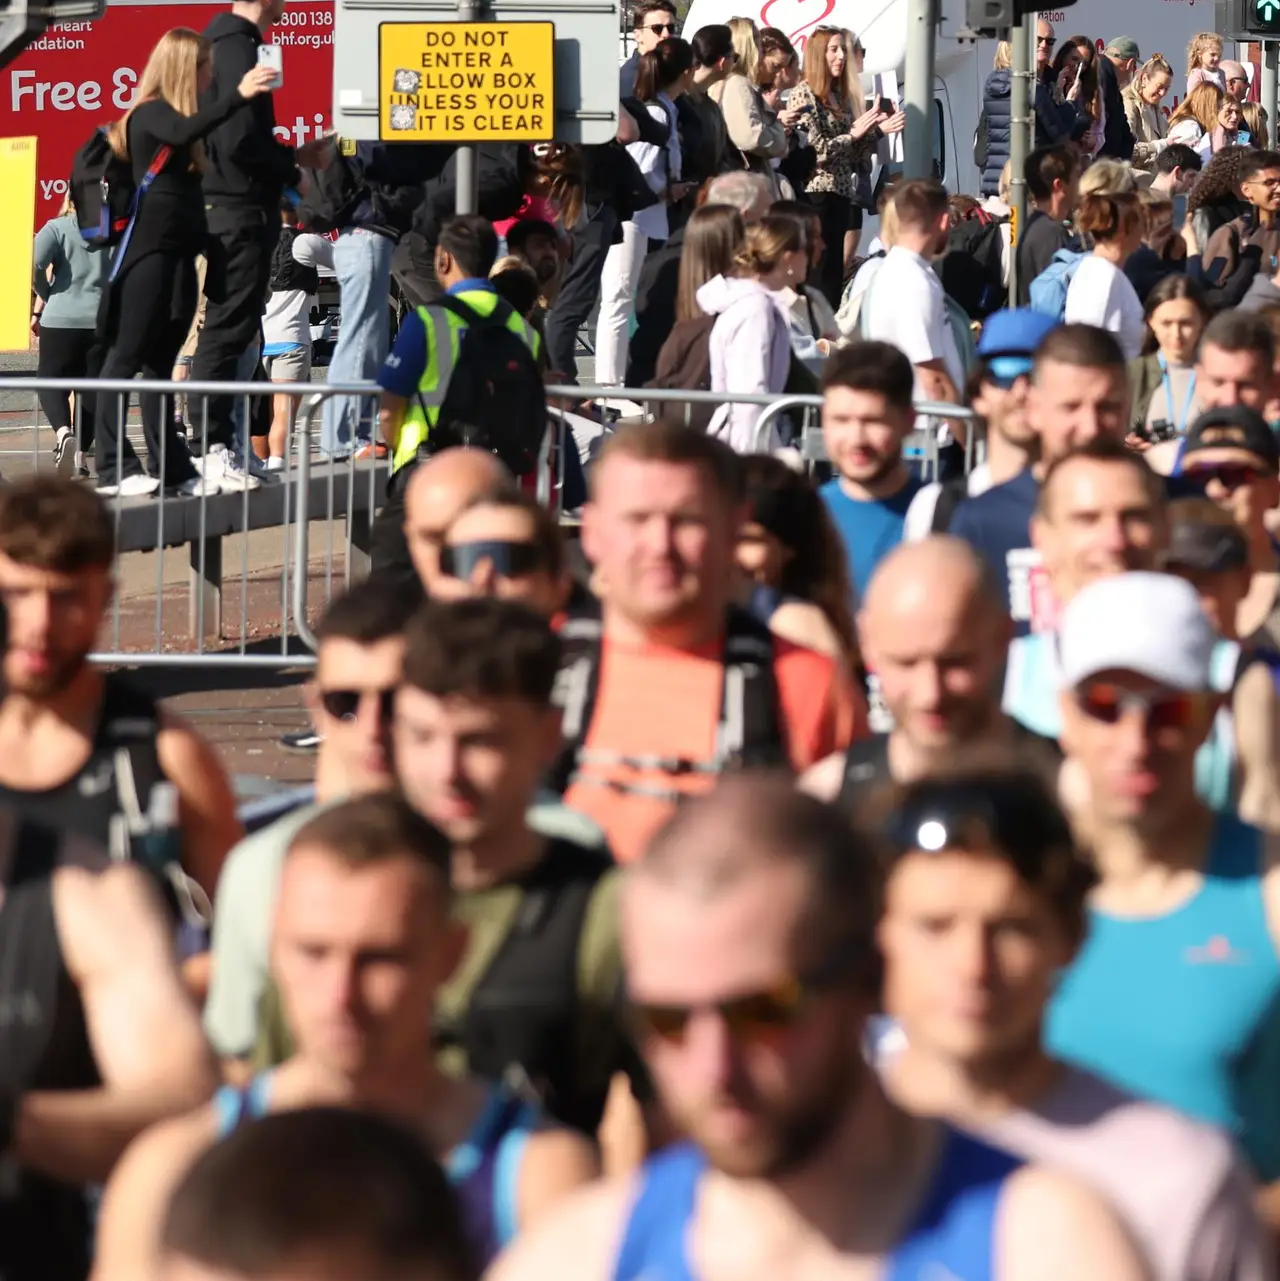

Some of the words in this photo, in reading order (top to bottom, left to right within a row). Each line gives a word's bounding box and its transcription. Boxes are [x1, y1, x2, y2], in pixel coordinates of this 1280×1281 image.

[426, 31, 456, 47] DO
[464, 31, 509, 47] NOT
[421, 52, 492, 67] ENTER
[500, 52, 513, 67] A
[417, 73, 484, 89] ELLOW
[494, 72, 536, 88] BOX
[11, 70, 102, 111] Free
[112, 67, 140, 110] &
[486, 94, 544, 109] YOUR
[445, 115, 465, 131] IS
[473, 115, 543, 131] CLEAR
